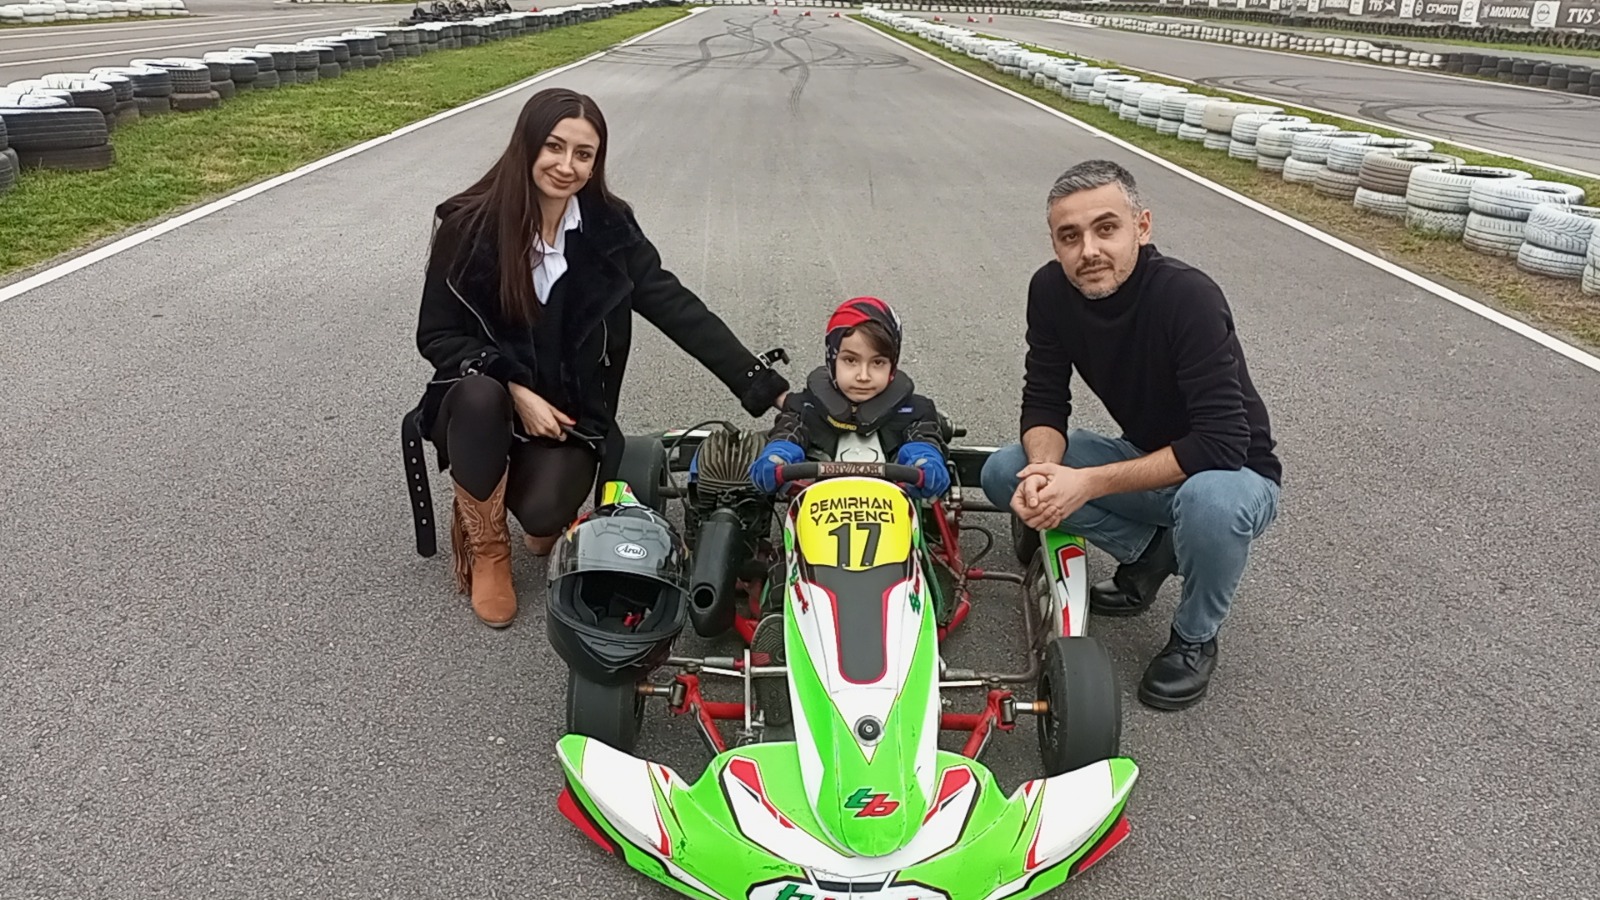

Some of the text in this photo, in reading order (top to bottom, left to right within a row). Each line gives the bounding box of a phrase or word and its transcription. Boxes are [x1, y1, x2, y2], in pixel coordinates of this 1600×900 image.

[1426, 3, 1459, 15] CFMOTO
[1489, 6, 1530, 19] MONDIAL
[1566, 8, 1595, 24] TVS
[810, 497, 893, 514] DEMIRHAN
[811, 510, 895, 526] YARENCI
[828, 522, 882, 567] 17
[844, 788, 900, 818] tb
